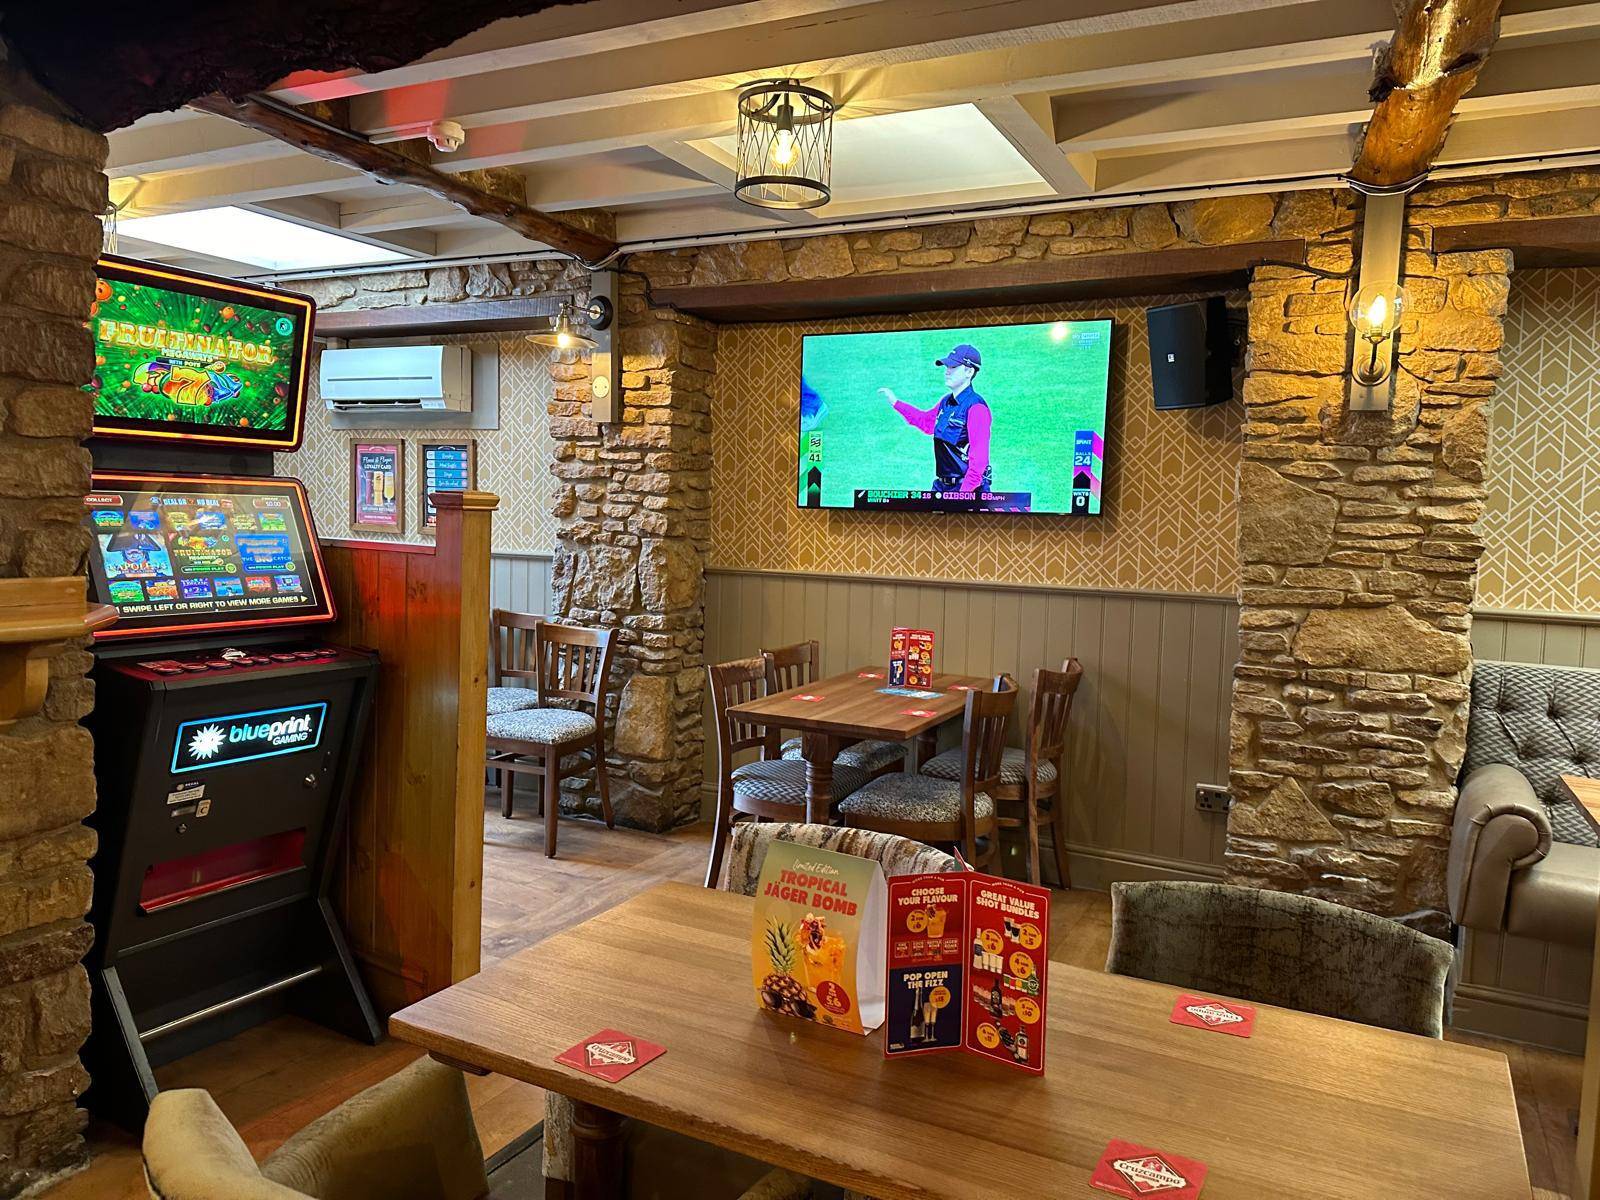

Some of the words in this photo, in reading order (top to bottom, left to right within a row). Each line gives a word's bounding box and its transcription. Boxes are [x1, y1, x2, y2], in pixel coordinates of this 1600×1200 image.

[99, 319, 275, 365] FRUITINATOR
[809, 453, 821, 462] 41
[1074, 456, 1091, 466] 24
[867, 490, 909, 499] BOUCHIER
[943, 492, 976, 500] GIBSON
[1076, 496, 1086, 507] 0
[173, 549, 232, 557] FRUITINATOR
[122, 604, 152, 613] SWIPE
[154, 603, 174, 611] LEFT
[175, 602, 188, 610] OR
[189, 601, 213, 609] RIGHT
[227, 599, 247, 607] VIEW
[248, 597, 271, 605] MORE
[272, 596, 299, 604] GAMES
[229, 714, 312, 742] blueprint
[272, 733, 308, 746] GAMING
[793, 858, 817, 872] Limited
[816, 863, 839, 875] Edition
[780, 869, 848, 897] TROPICAL
[911, 887, 945, 896] CHOOSE
[764, 881, 808, 905] JÄGER
[811, 892, 858, 916] BOMB
[897, 896, 921, 906] YOUR
[922, 894, 958, 904] FLAVOUR
[980, 890, 1007, 904] GREAT
[1009, 896, 1035, 910] VALUE
[976, 896, 999, 909] SHOT
[1001, 903, 1040, 919] BUNDLES
[903, 973, 923, 982] POP
[924, 971, 949, 979] OPEN
[907, 980, 924, 989] THE
[925, 979, 944, 987] FIZZ
[1119, 1162, 1181, 1185] Cruzcampo
